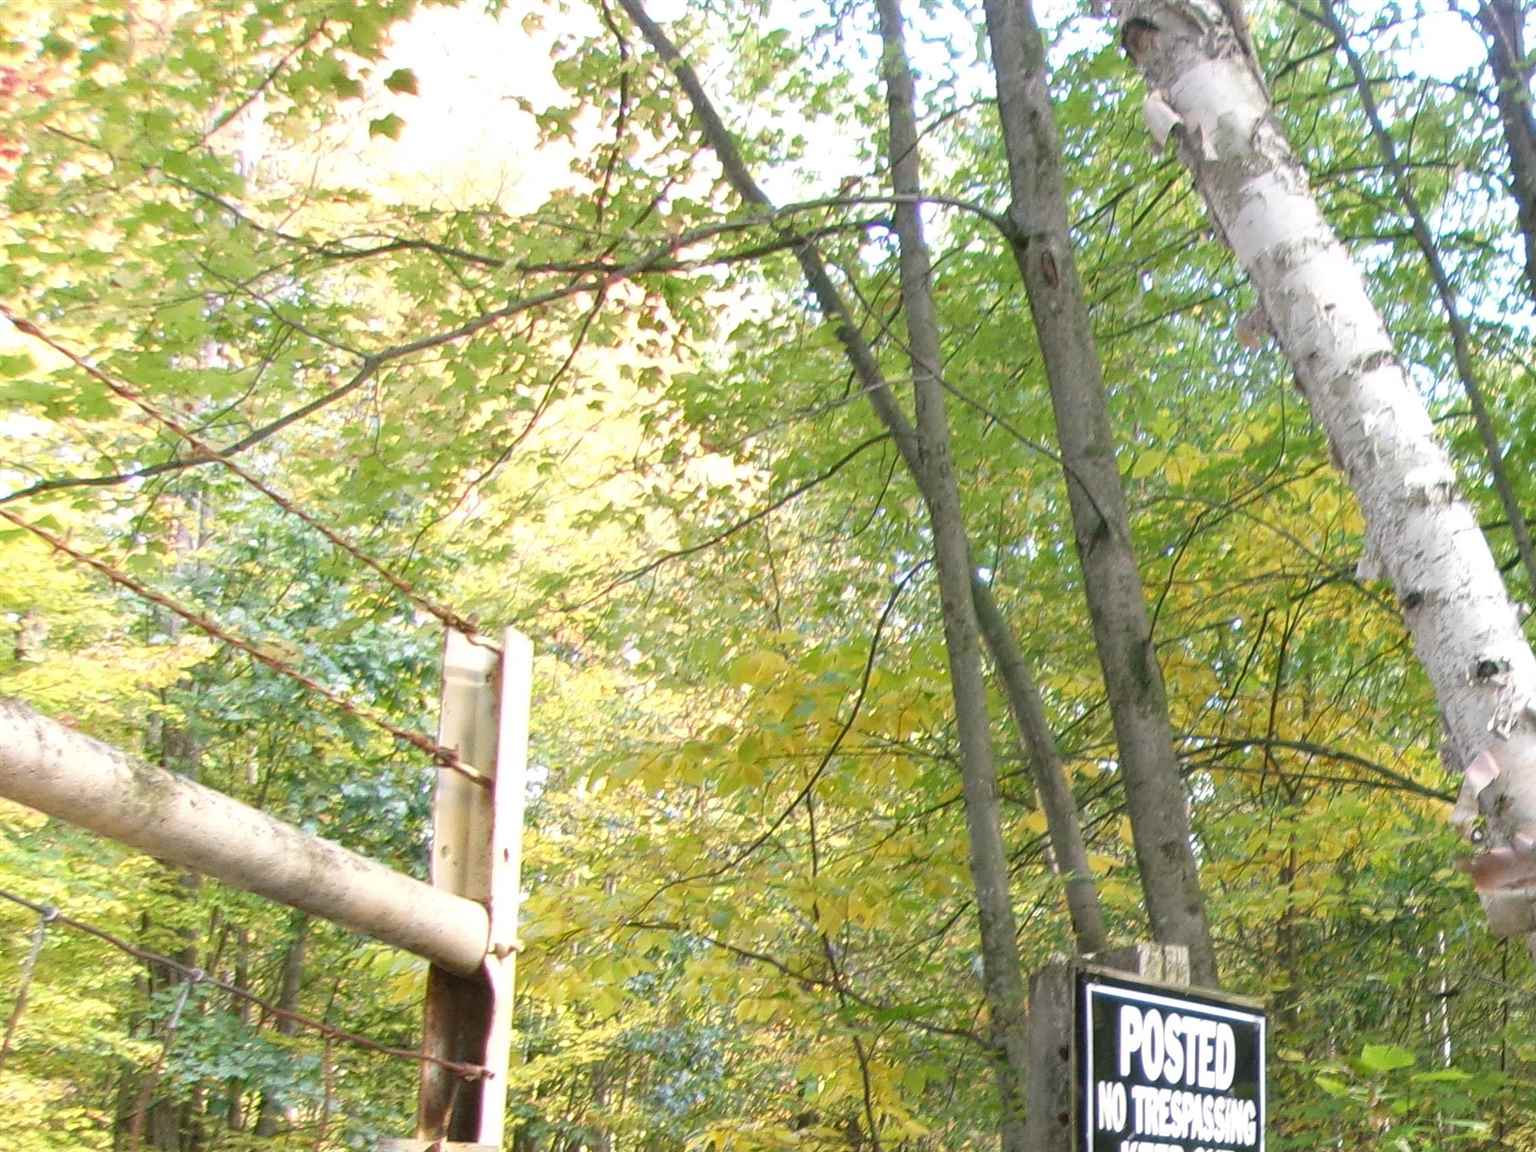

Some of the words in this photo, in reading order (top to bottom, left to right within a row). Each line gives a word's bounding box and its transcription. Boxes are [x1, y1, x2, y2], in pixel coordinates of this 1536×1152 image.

[1120, 1005, 1236, 1091] POSTED
[1098, 1081, 1127, 1132] NO
[1132, 1085, 1256, 1145] TRESPASSING
